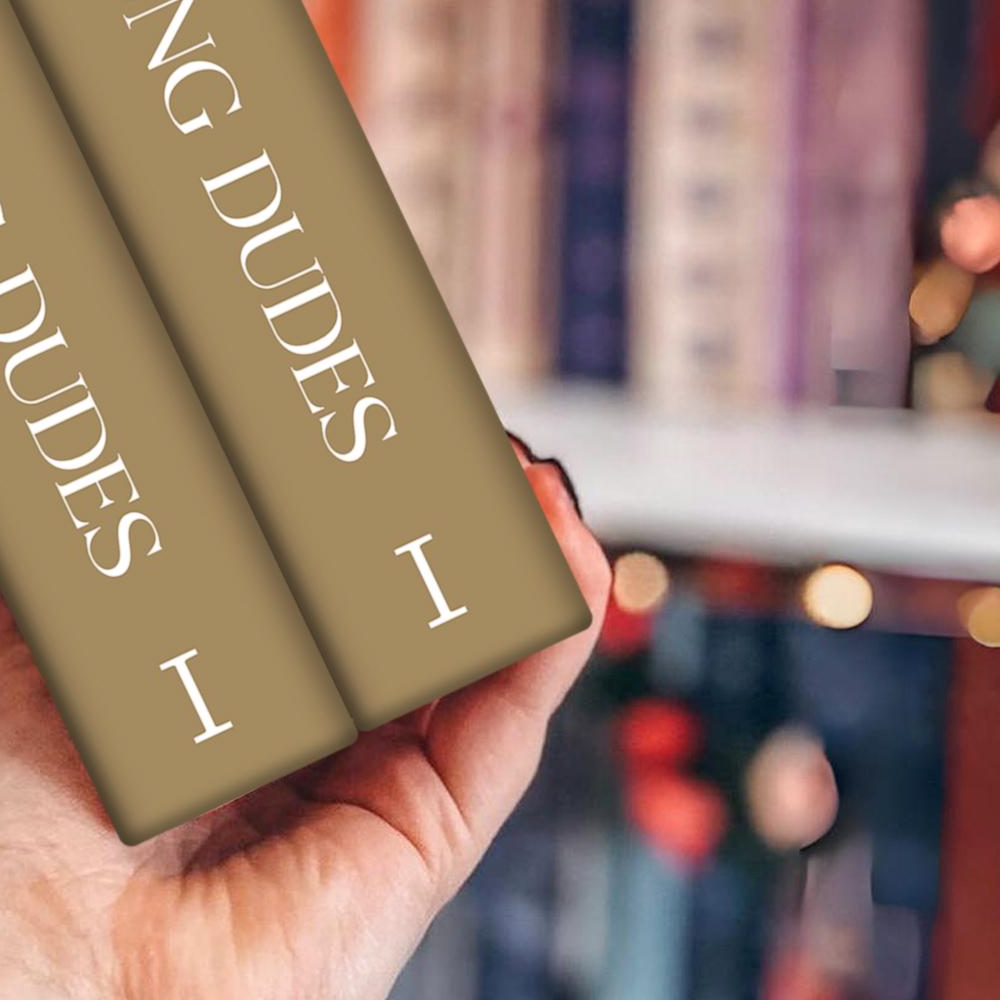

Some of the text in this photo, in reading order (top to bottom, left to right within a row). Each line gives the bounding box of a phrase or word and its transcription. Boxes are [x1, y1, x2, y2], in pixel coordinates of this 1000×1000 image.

[199, 148, 399, 464] DUDES
[392, 532, 469, 630] I
[158, 647, 235, 745] I
